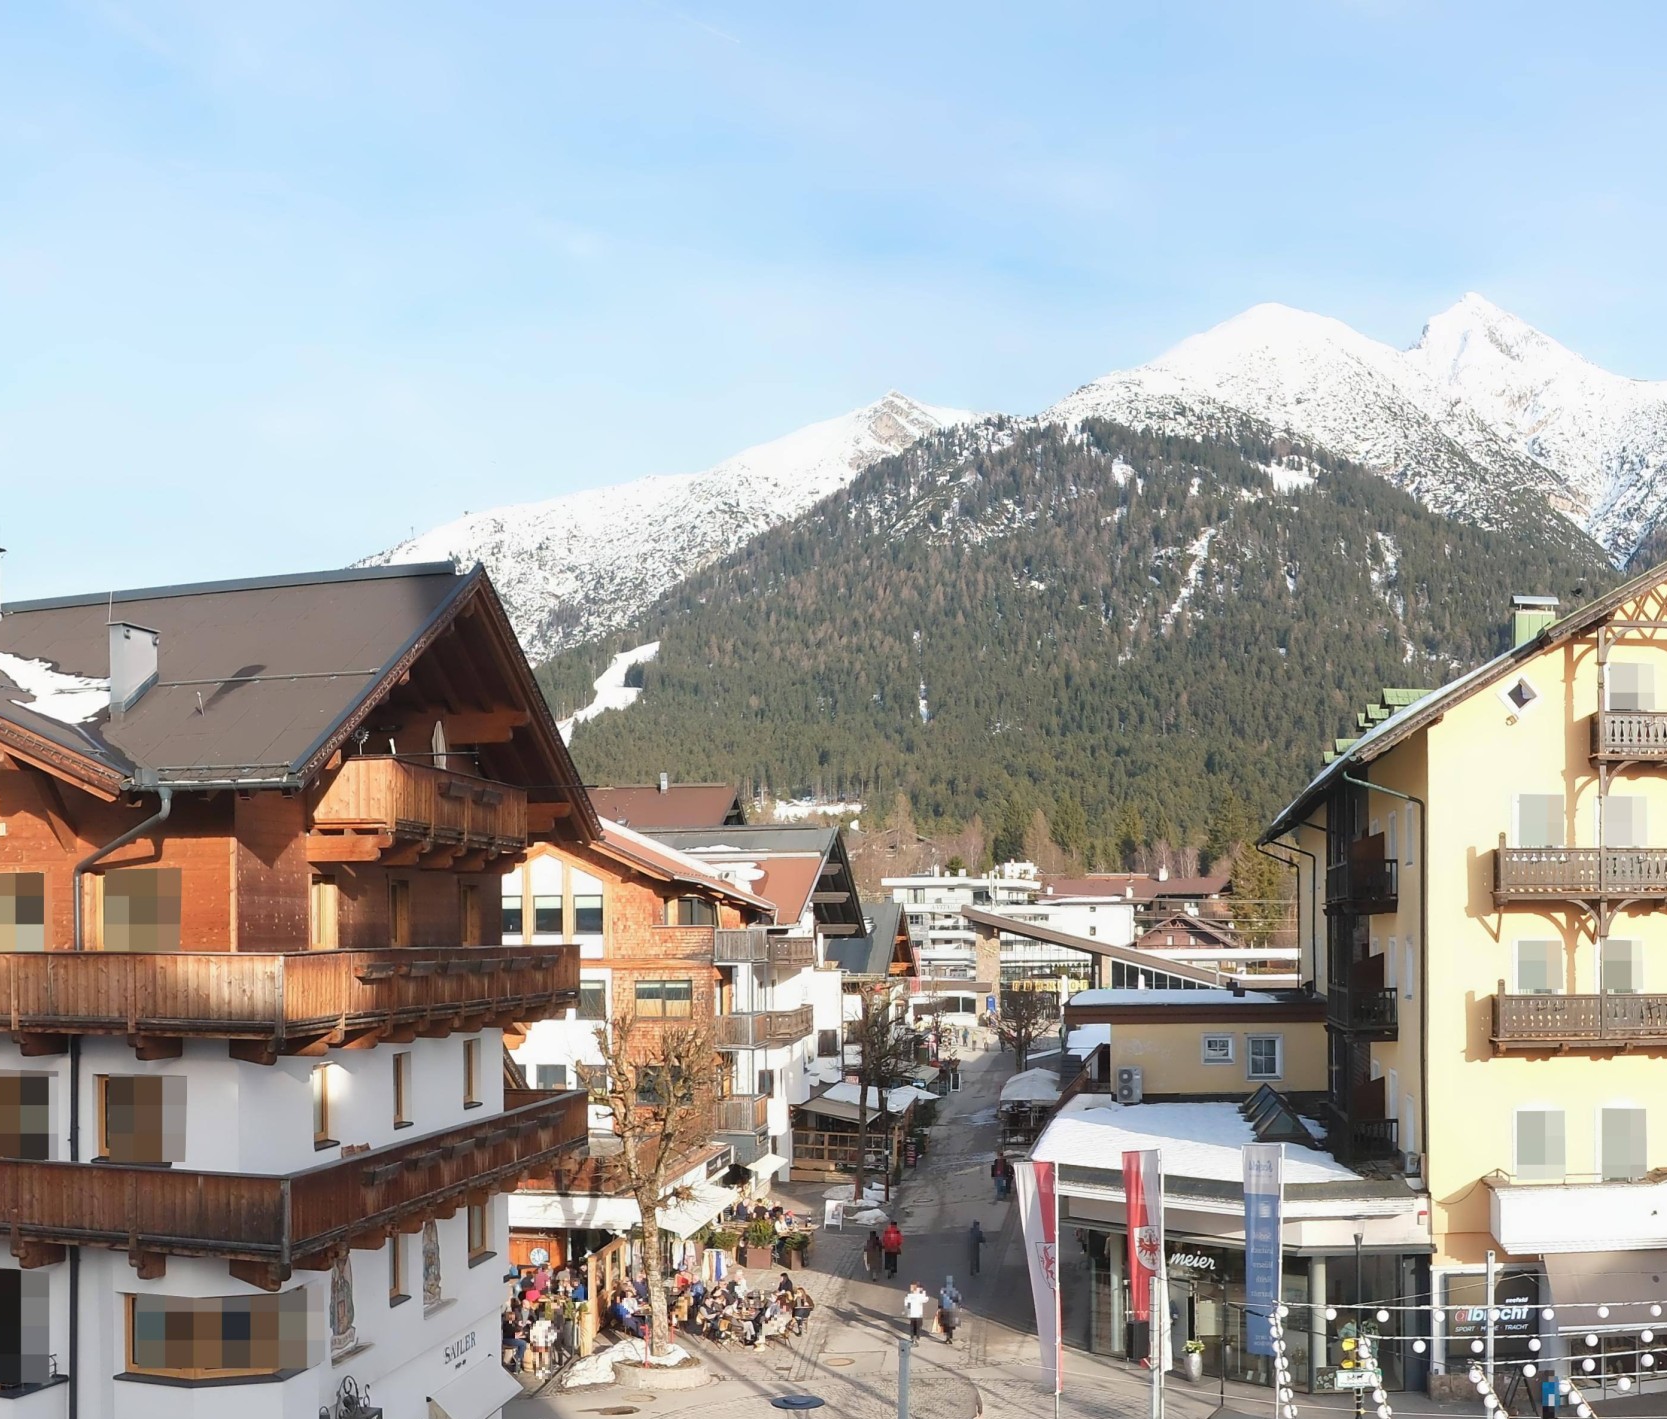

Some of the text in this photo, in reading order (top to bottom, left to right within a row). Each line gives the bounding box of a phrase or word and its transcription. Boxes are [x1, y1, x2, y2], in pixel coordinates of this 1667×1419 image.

[1170, 1250, 1216, 1270] meier
[1454, 1307, 1529, 1322] albcht
[1455, 1325, 1476, 1333] SPORT
[1504, 1323, 1529, 1331] TRACHT
[444, 1331, 477, 1365] SAILER
